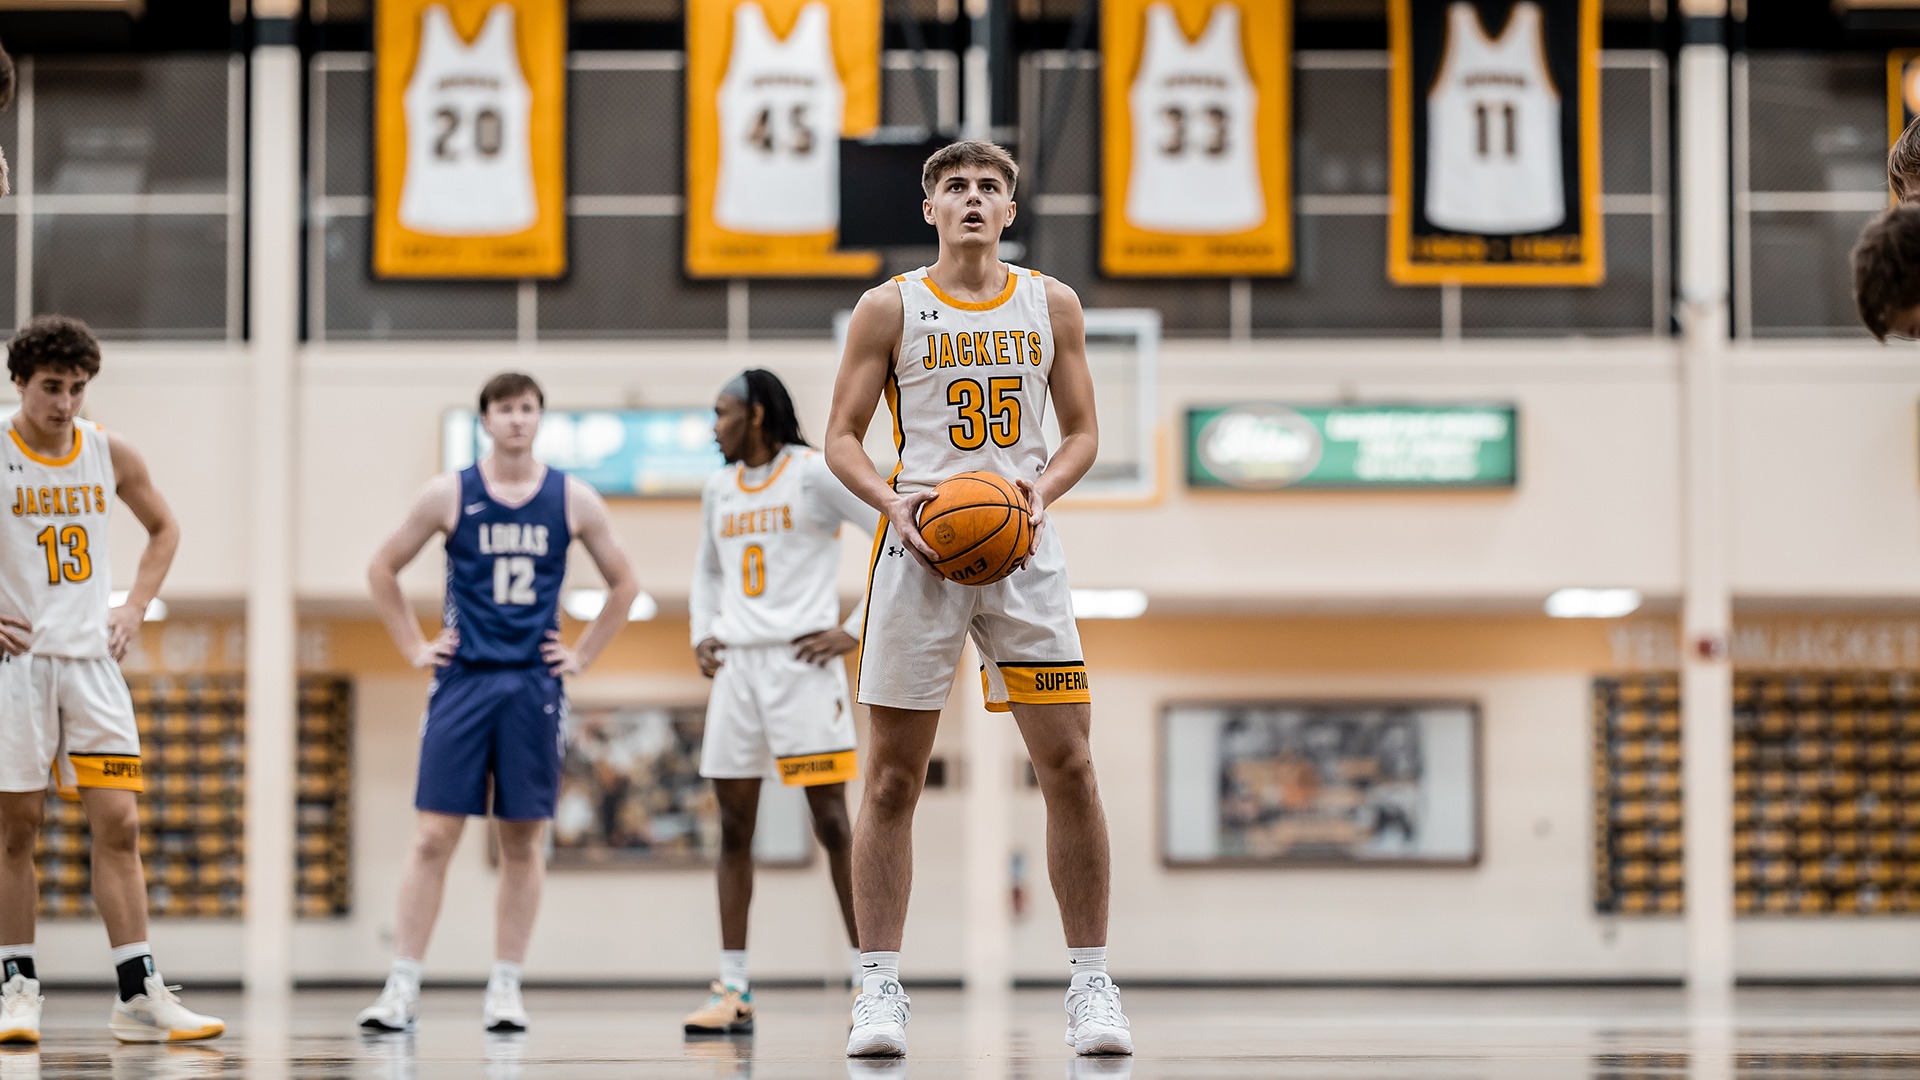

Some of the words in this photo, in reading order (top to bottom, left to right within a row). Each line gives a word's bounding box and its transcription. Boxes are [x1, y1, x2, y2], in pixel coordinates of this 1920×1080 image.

[432, 106, 503, 161] 20
[747, 104, 815, 157] 45
[1472, 102, 1517, 157] 11
[923, 331, 1042, 370] JACKETS
[946, 376, 1023, 451] 35
[12, 485, 106, 516] JACKETS
[720, 504, 792, 538] JACKETS
[37, 524, 93, 587] 13
[478, 522, 549, 557] LORAS
[493, 556, 537, 606] 12
[742, 543, 767, 599] 0
